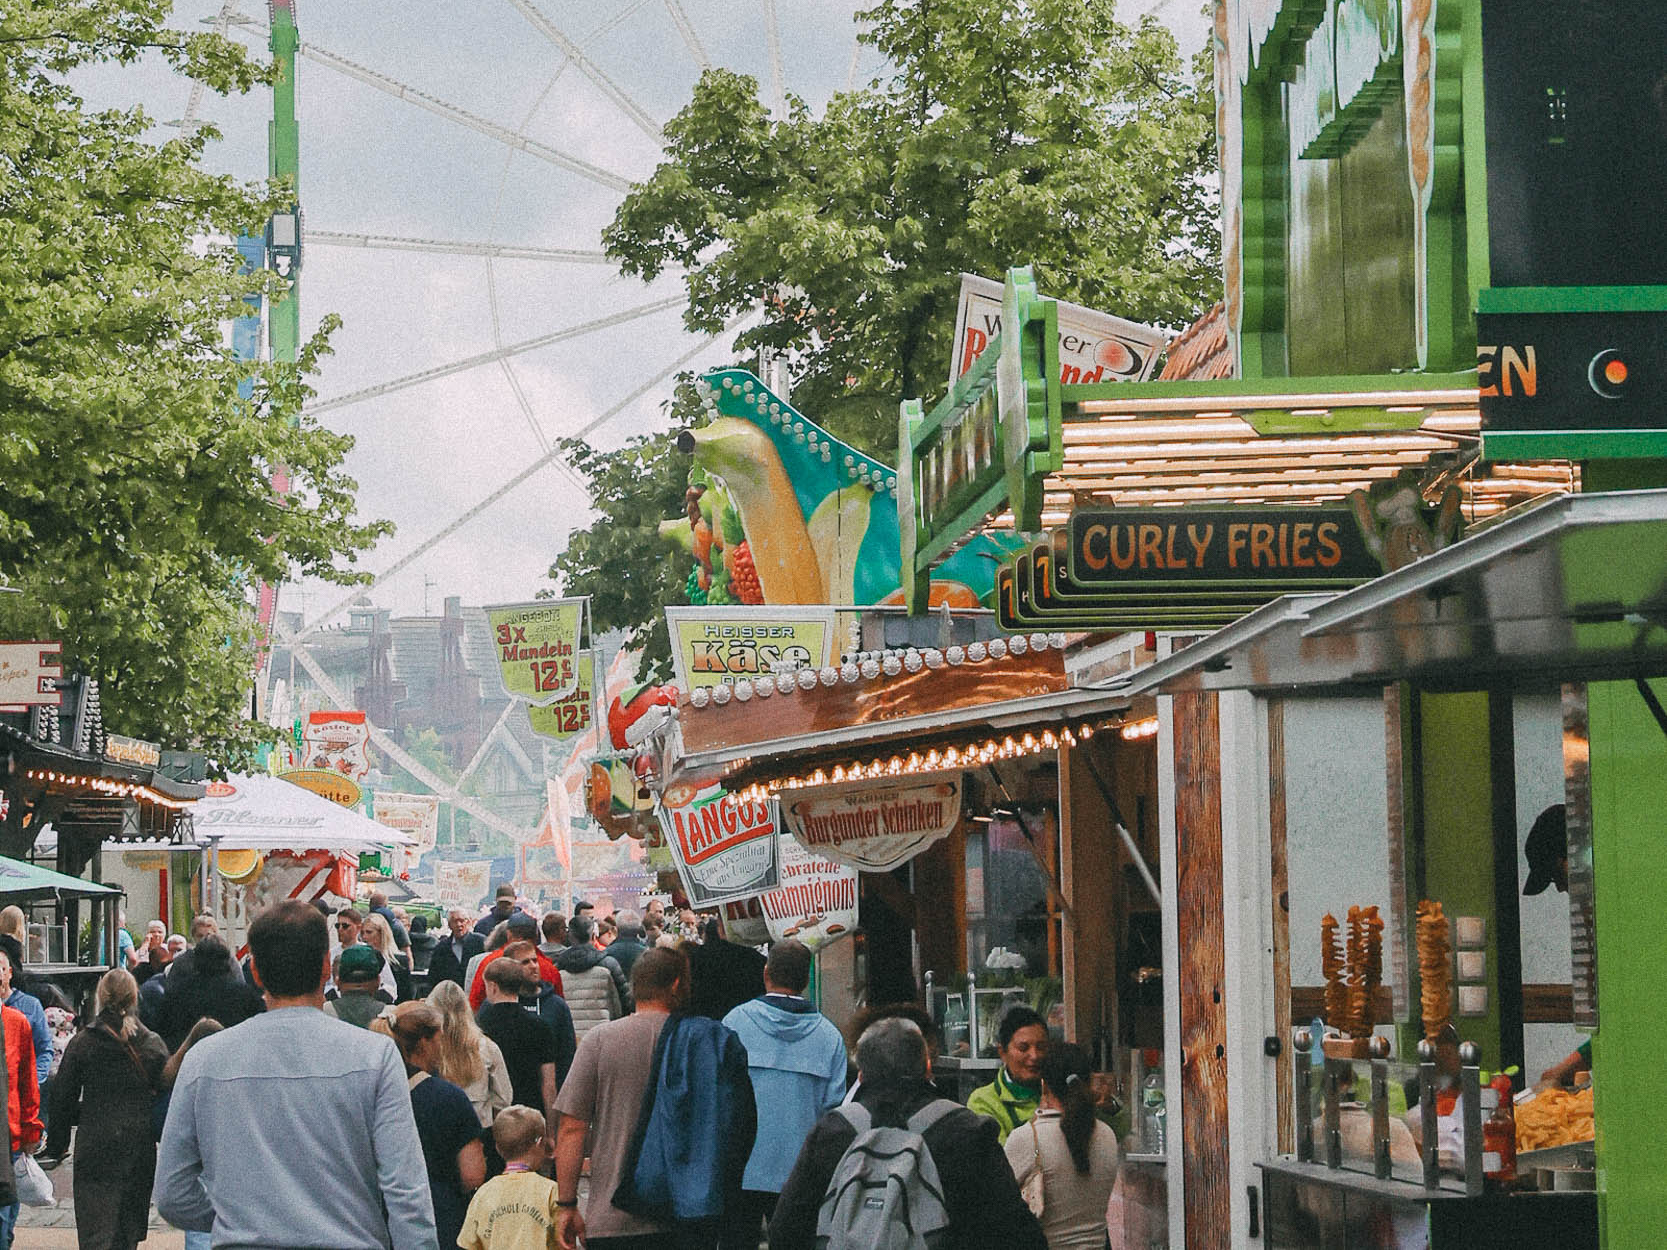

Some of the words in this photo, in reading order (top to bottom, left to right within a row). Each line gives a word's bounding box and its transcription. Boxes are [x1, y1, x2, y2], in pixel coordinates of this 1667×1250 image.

[1083, 522, 1214, 570] CURLY
[1228, 521, 1342, 567] FRIES
[703, 625, 795, 639] HEISSER
[501, 639, 574, 662] Mandeln
[690, 639, 812, 674] Käse
[801, 806, 880, 847] Burgunder
[880, 799, 945, 836] Schinken
[781, 861, 841, 880] ebratene
